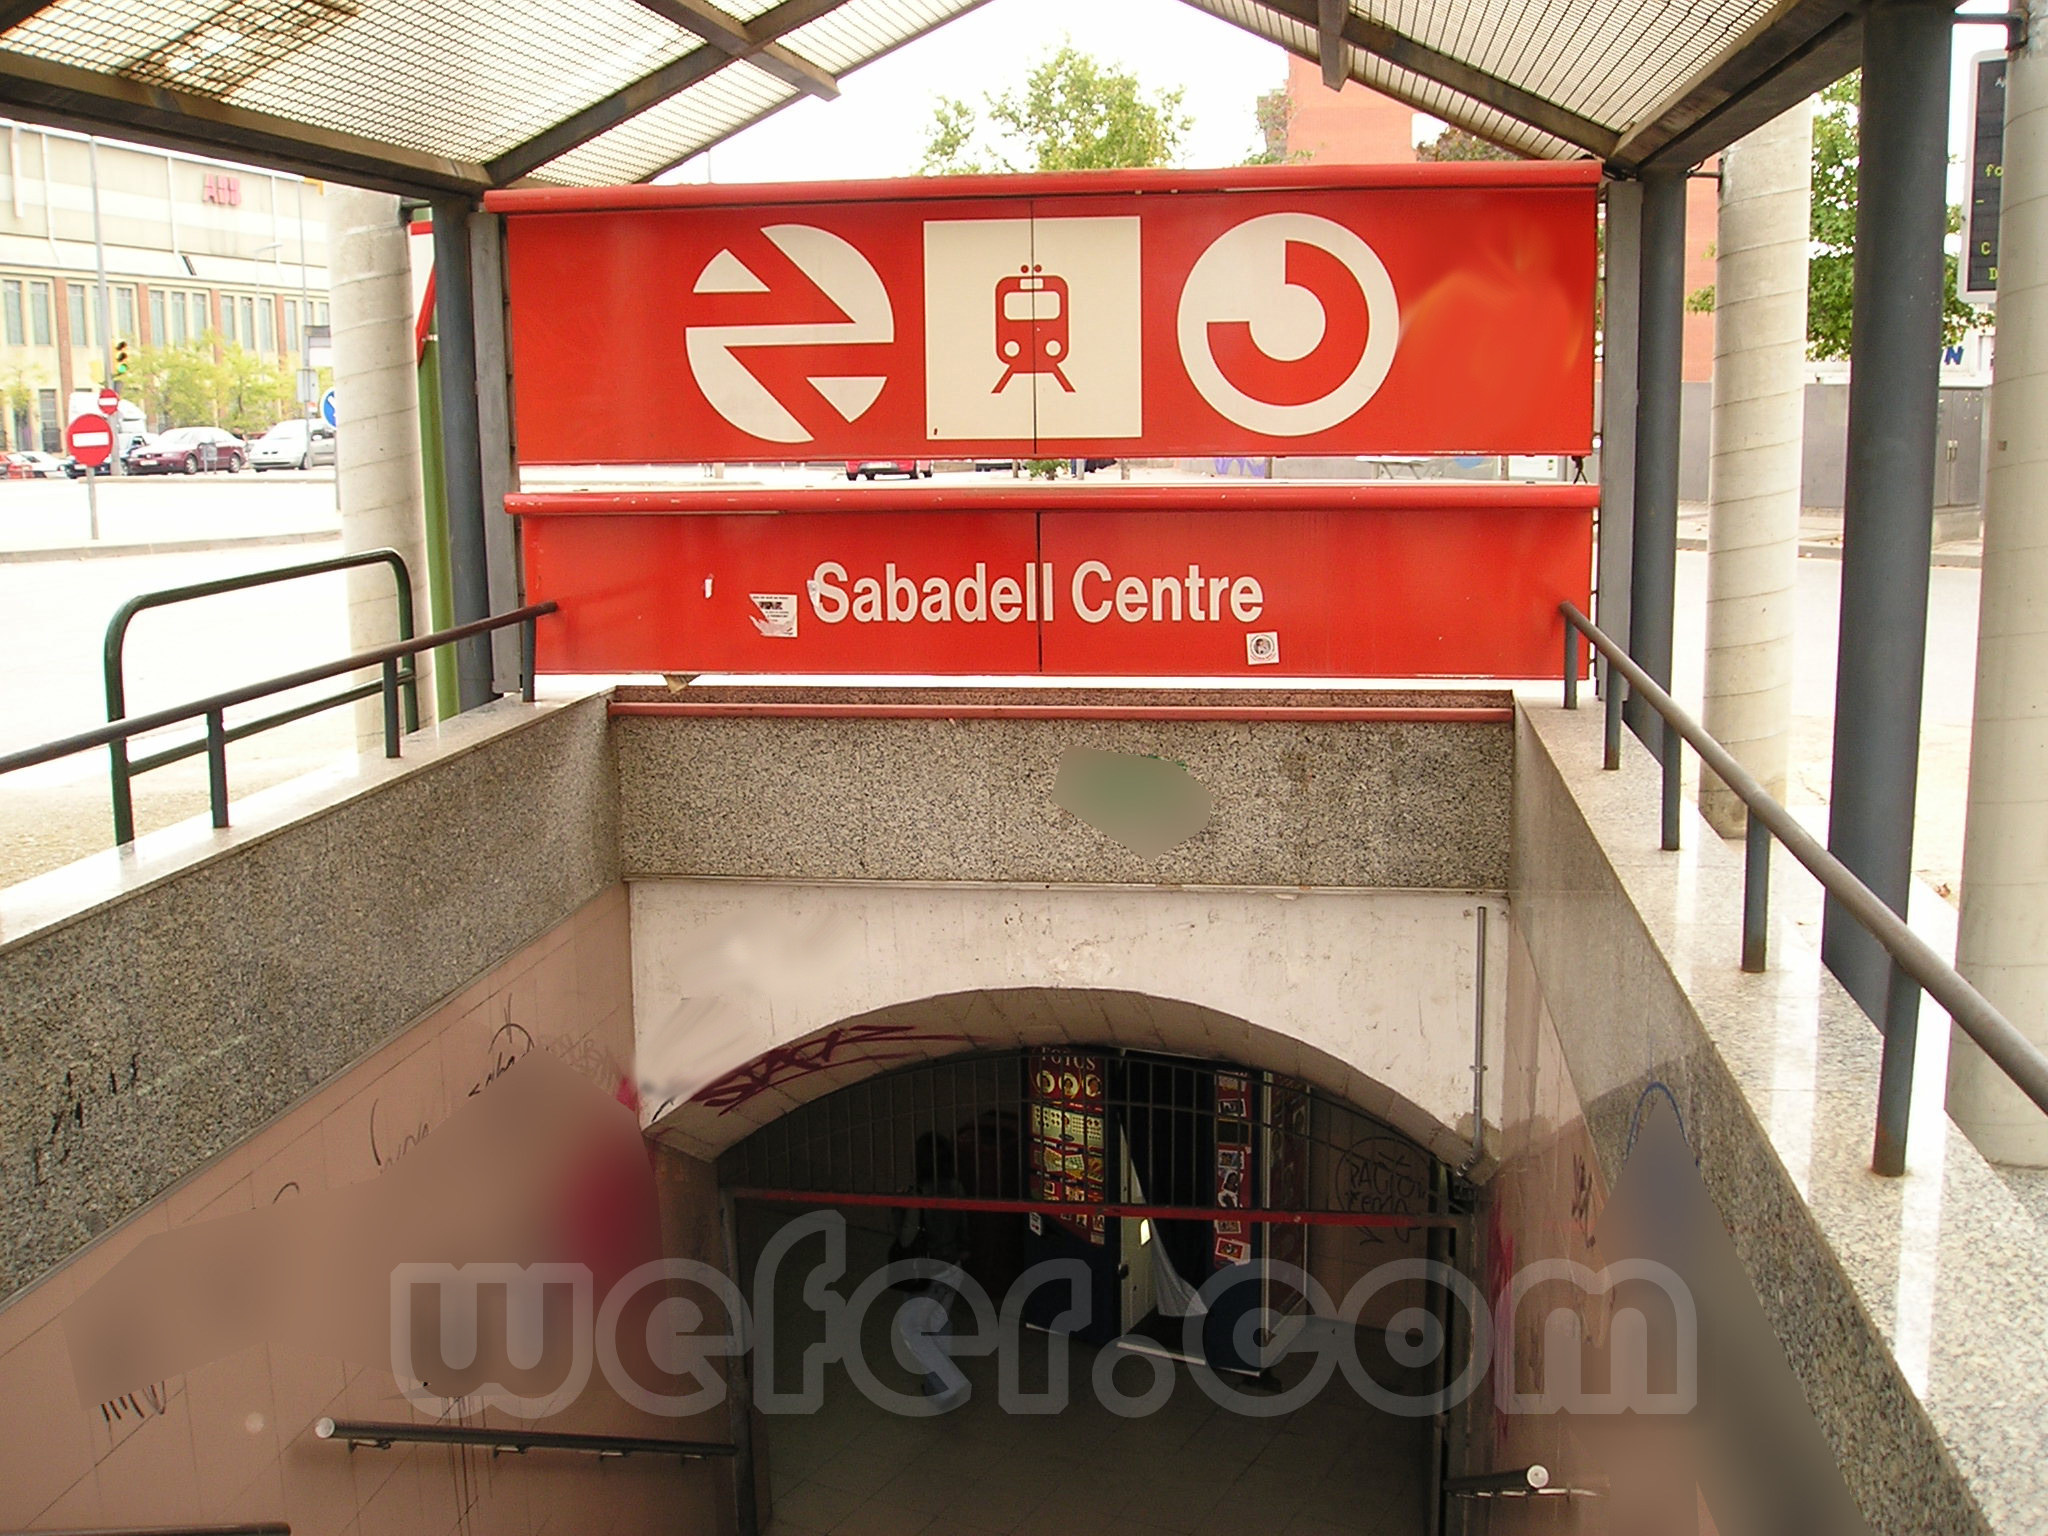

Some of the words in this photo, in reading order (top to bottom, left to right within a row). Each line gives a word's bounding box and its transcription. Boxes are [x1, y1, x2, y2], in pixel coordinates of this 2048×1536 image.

[203, 173, 242, 206] ABB
[811, 561, 1054, 622] Sabadell
[1071, 560, 1265, 623] Centre
